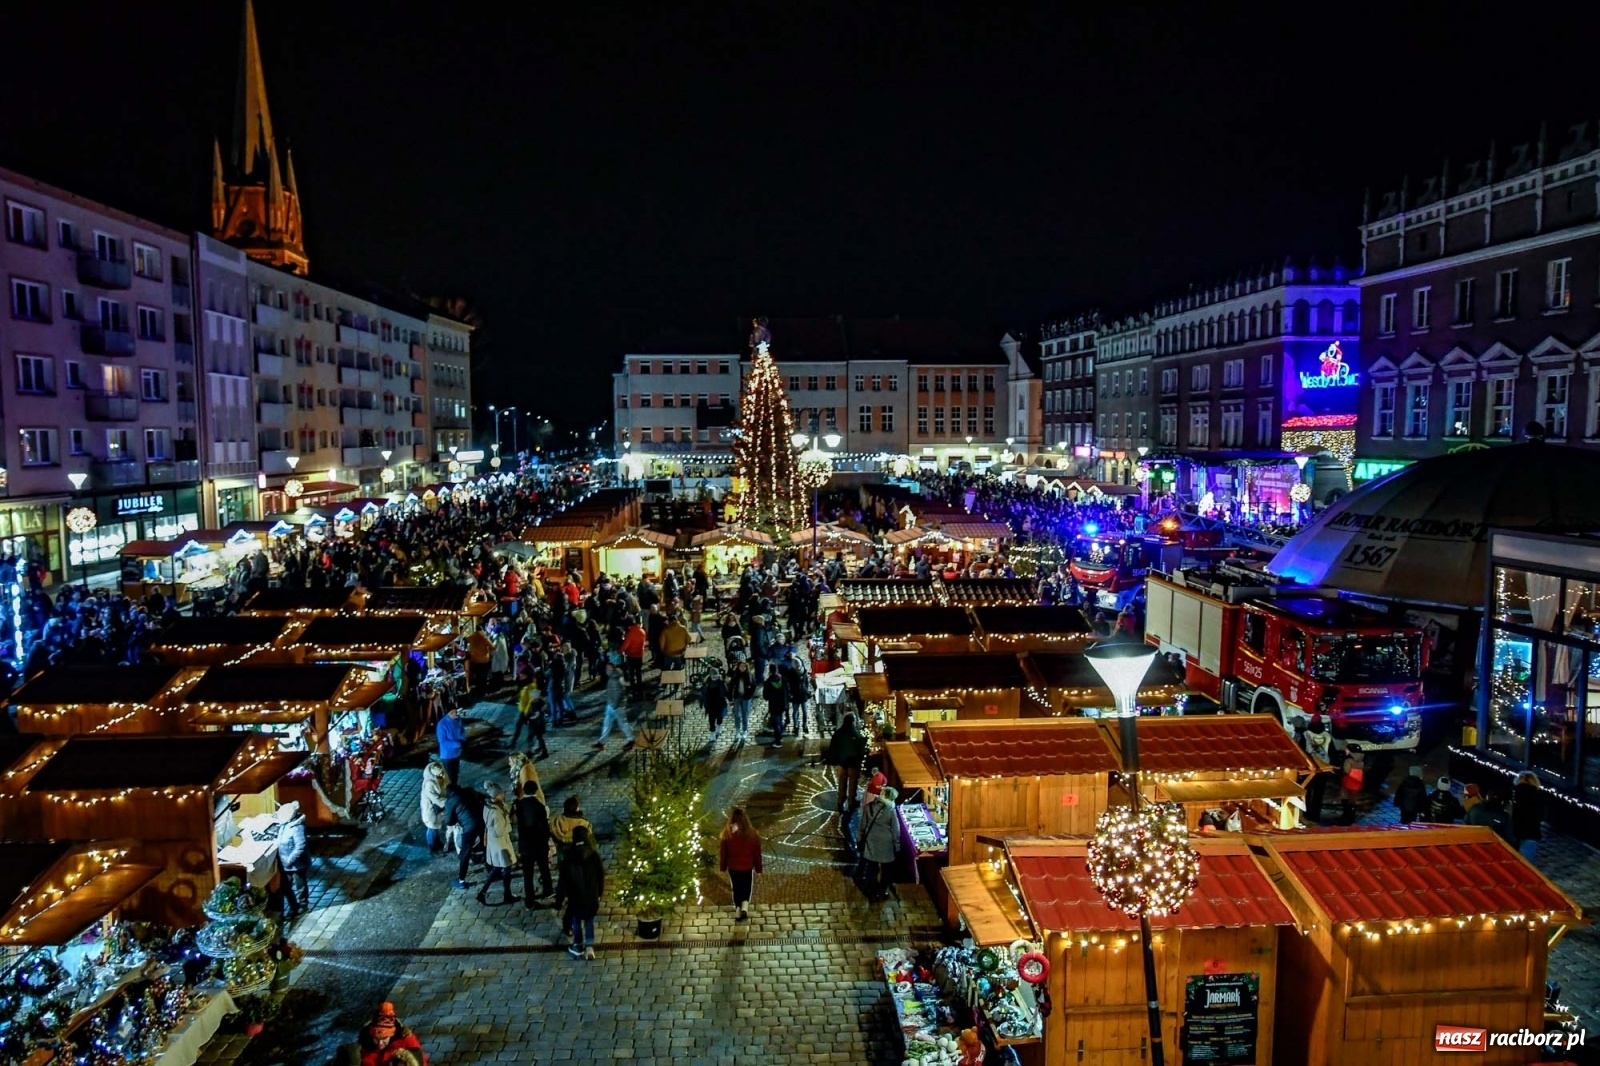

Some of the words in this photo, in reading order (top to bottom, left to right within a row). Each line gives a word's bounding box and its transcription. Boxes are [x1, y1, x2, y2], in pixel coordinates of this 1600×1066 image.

[117, 495, 164, 511] JUBILER
[1345, 545, 1397, 566] 1567
[1358, 687, 1389, 695] SCANIA
